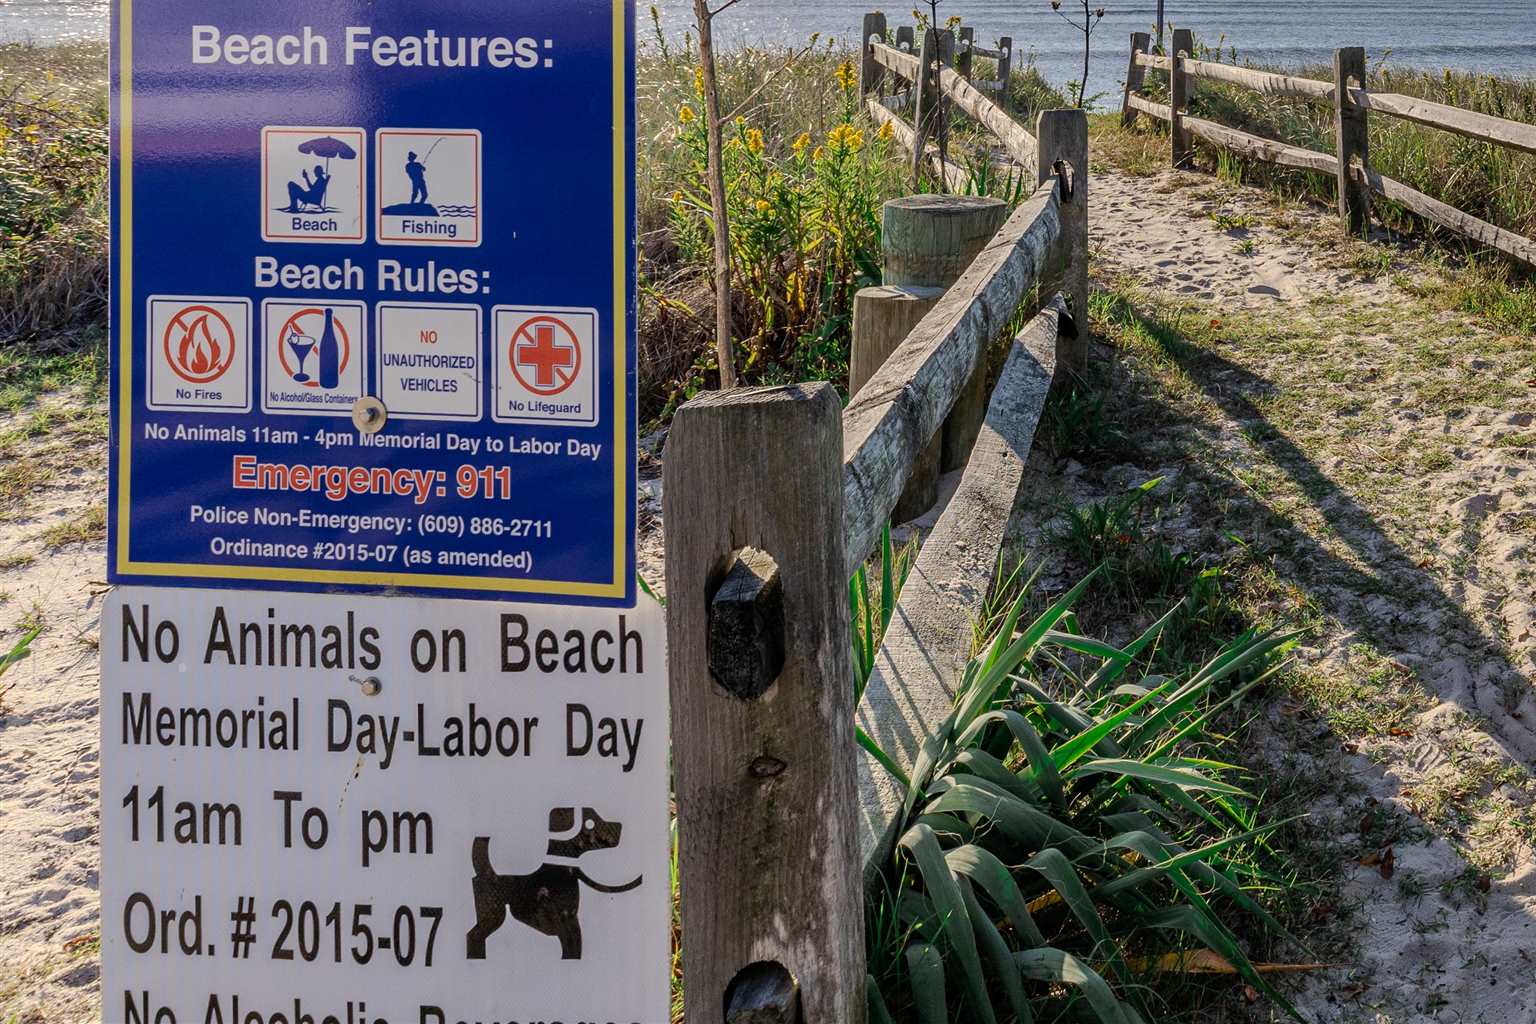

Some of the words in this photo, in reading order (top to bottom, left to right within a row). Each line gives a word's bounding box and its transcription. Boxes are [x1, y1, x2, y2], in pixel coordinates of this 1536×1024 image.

[191, 25, 327, 66] Beach
[345, 26, 553, 68] Features:
[292, 217, 337, 231] Beach
[402, 220, 457, 238] Fishing
[255, 256, 364, 290] Beach
[378, 259, 490, 294] Rules:
[420, 331, 438, 344] NO
[383, 354, 475, 370] UNAUTHORIZED
[176, 388, 192, 400] No
[195, 389, 222, 400] Fires
[270, 392, 279, 401] No
[280, 392, 323, 403] Alcohol/Glass
[400, 377, 458, 393] VEHICLES
[509, 400, 524, 411] No
[528, 401, 581, 414] Lifeguard
[144, 423, 169, 440] No
[174, 424, 247, 443] Animals
[252, 427, 297, 444] 11am
[314, 429, 353, 449] 4pm
[359, 432, 441, 450] Memorial
[446, 434, 481, 454] Day
[486, 436, 504, 452] to
[509, 437, 561, 455] Labor
[566, 439, 602, 461] Day
[232, 454, 447, 505] Emergency:
[456, 464, 512, 500] 911
[191, 505, 248, 525] Police
[254, 507, 412, 536] Non-Emergency:
[418, 514, 465, 536] (609)
[470, 517, 552, 538] 886-2711
[210, 536, 308, 559] Ordinance
[312, 542, 398, 563] #2015-07
[403, 547, 431, 567] (as
[437, 549, 533, 573] amended)
[122, 604, 180, 664] No
[203, 606, 381, 671] Animals
[411, 629, 467, 673] on
[500, 613, 644, 674] Beach
[122, 692, 299, 751] Memorial
[328, 698, 539, 770] Day-Labor
[566, 703, 644, 773] Day
[122, 785, 242, 845] 11am
[273, 790, 329, 850] To
[361, 810, 434, 868] pm
[123, 892, 215, 956] Ord.
[271, 899, 444, 967] 2015-07
